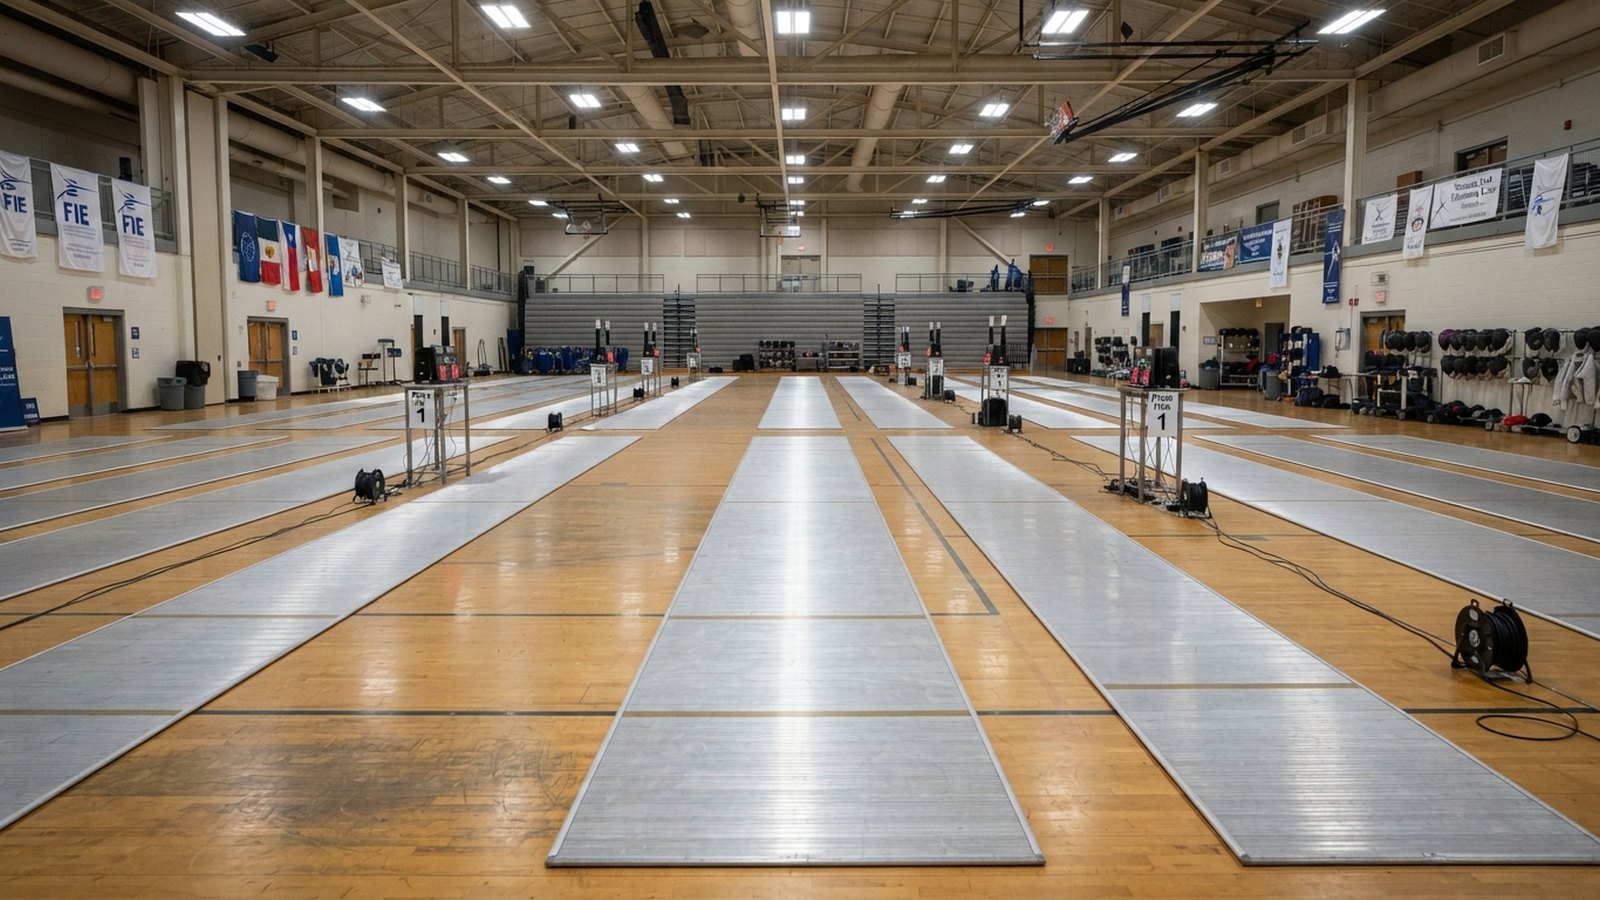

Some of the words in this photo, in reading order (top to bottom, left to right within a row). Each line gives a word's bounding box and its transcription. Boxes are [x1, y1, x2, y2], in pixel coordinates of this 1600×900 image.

[3, 192, 28, 213] FIE
[63, 201, 90, 226] FIE
[122, 213, 145, 237] FIE
[416, 407, 424, 423] 1
[1157, 412, 1165, 431] 1
